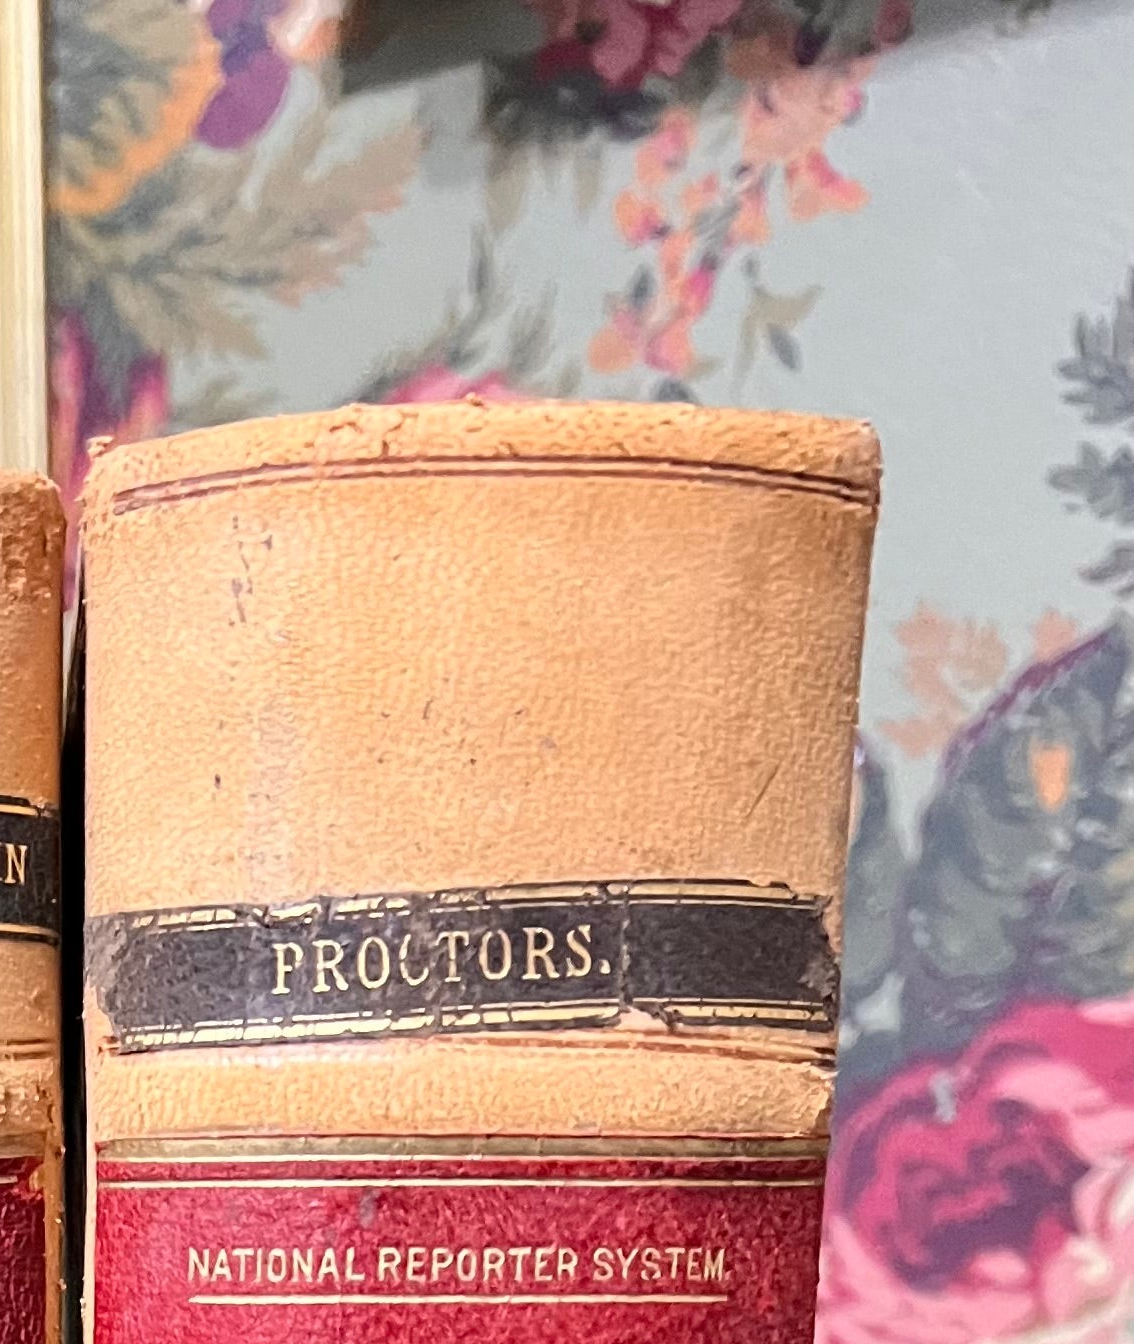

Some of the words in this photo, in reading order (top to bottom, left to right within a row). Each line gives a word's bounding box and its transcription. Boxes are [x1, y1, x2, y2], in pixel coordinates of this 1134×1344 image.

[271, 924, 613, 996] PROCTORS.
[186, 1247, 365, 1283] NATIONAL
[377, 1245, 579, 1282] REPORTER
